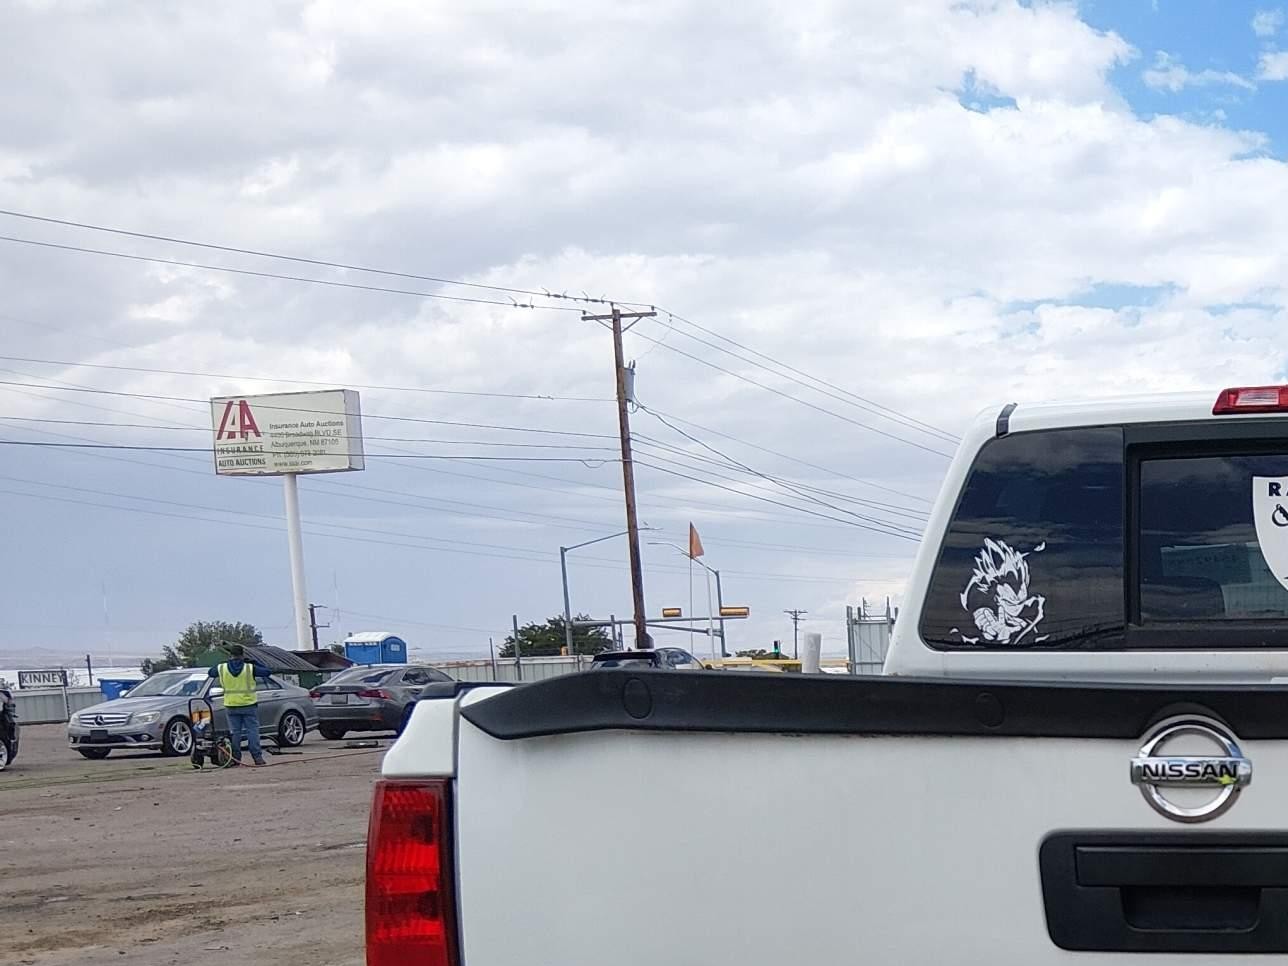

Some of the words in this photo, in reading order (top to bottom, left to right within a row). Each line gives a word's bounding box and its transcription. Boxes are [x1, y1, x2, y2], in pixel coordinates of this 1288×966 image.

[269, 422, 299, 430] Insurance
[316, 419, 344, 427] Auctions
[217, 445, 264, 455] INSURANCE
[219, 459, 235, 467] AUTO
[236, 458, 266, 466] AUCTIONS
[21, 672, 65, 683] KINNEY
[1143, 763, 1237, 778] NISSAN
